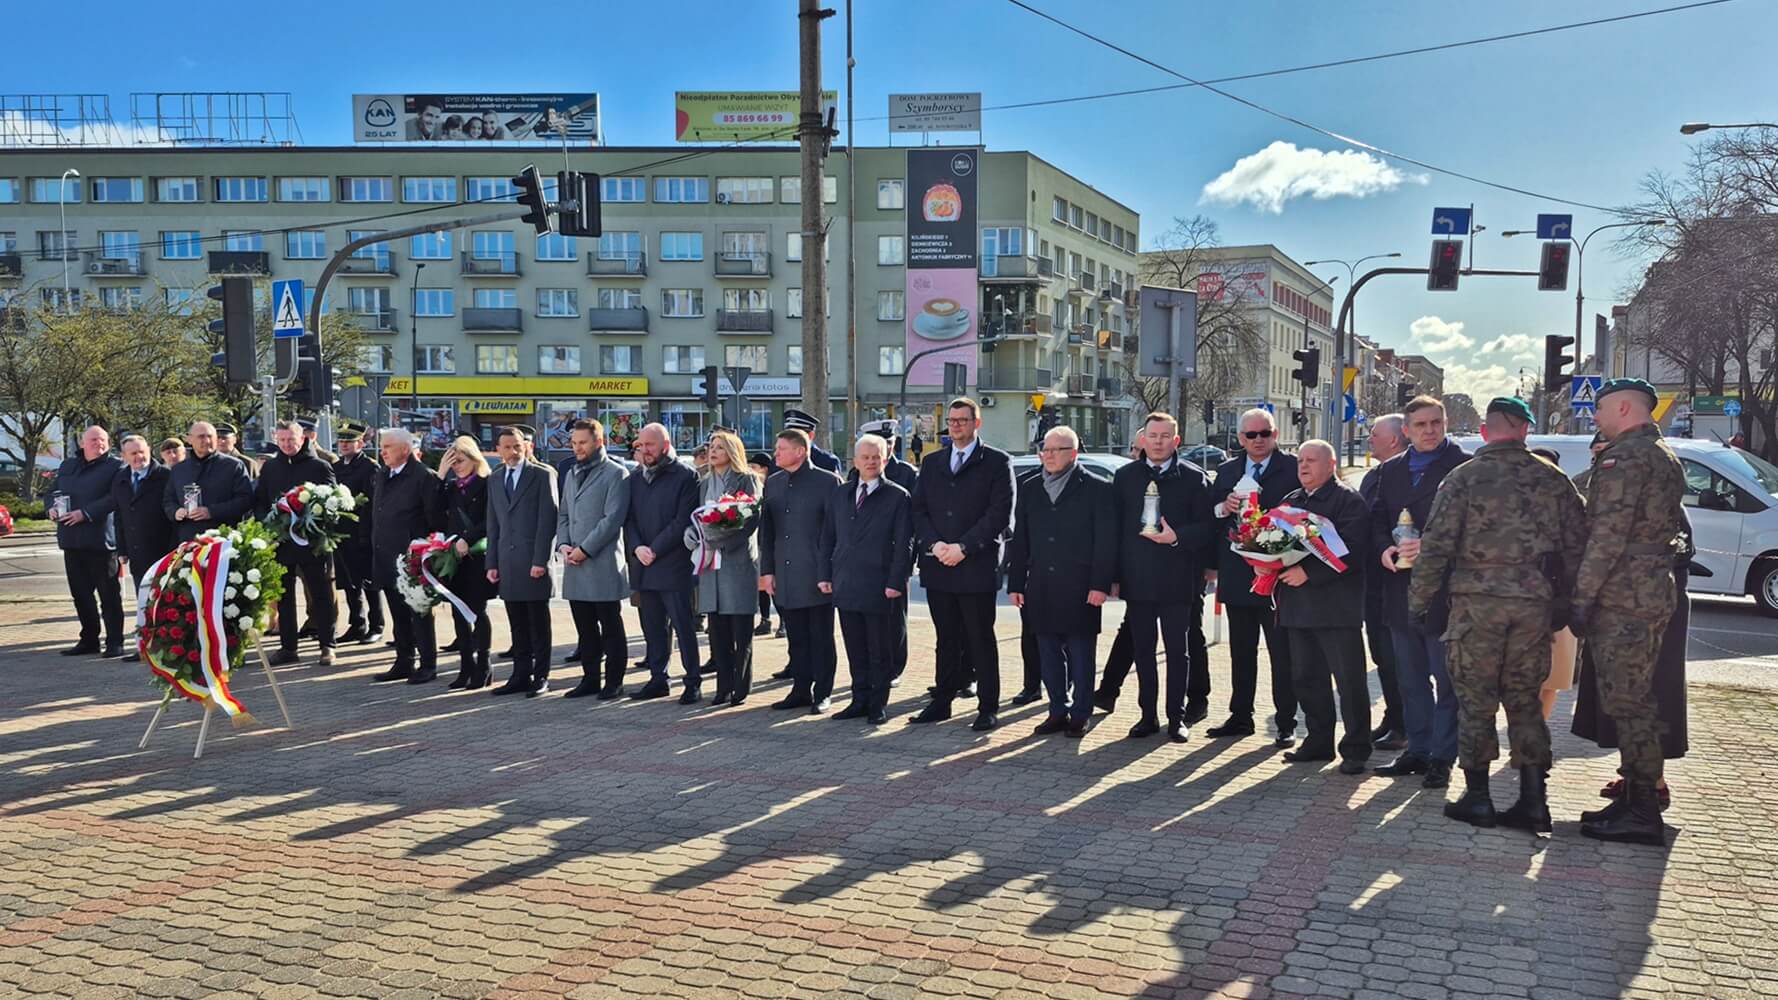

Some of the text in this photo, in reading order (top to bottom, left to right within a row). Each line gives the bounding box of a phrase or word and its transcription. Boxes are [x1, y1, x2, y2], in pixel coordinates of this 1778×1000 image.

[367, 108, 396, 118] KAN
[723, 114, 783, 122] 85 869 66 99
[589, 381, 633, 391] MARKET
[481, 401, 528, 410] LEWIATAN
